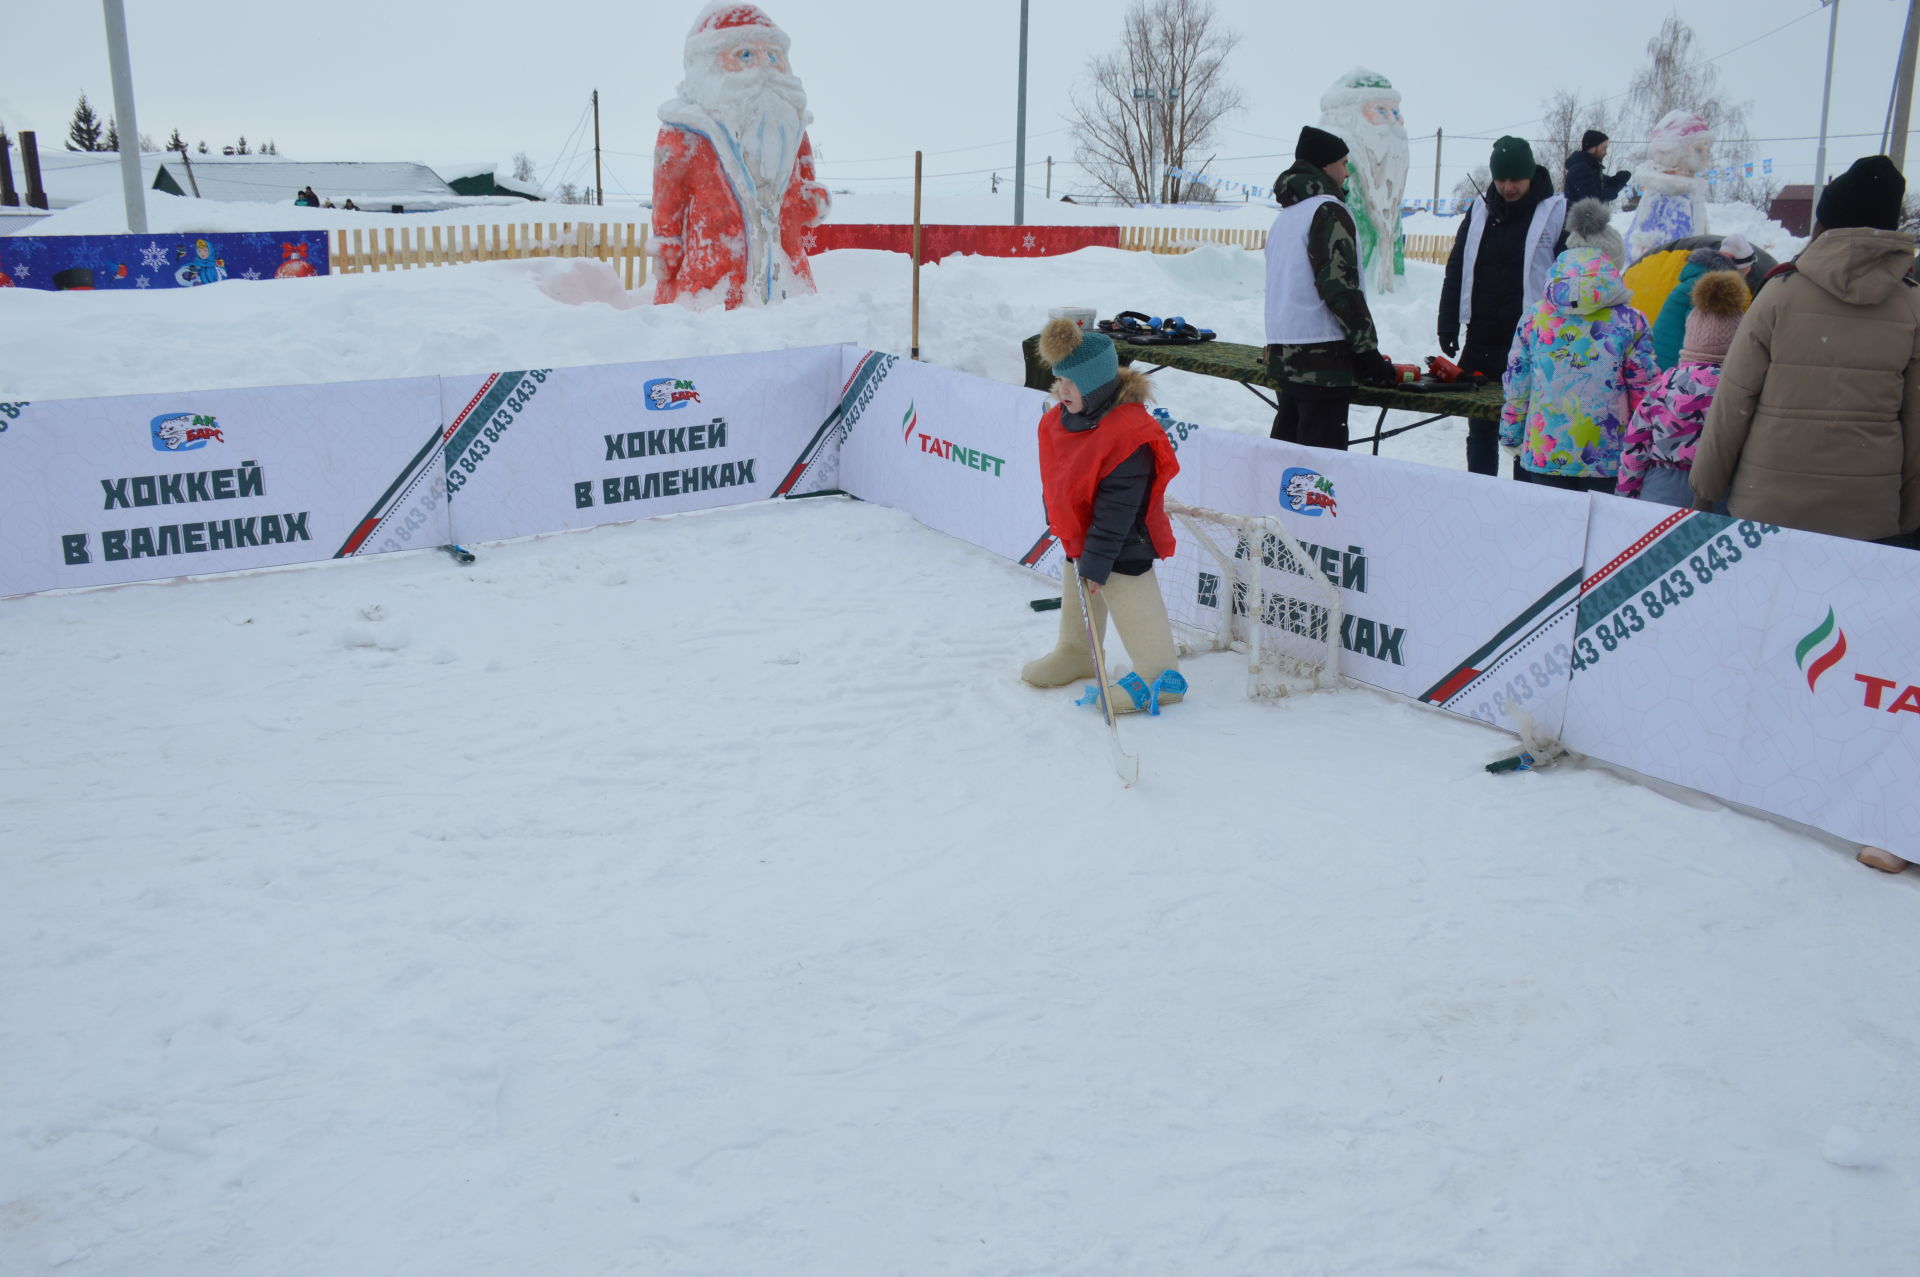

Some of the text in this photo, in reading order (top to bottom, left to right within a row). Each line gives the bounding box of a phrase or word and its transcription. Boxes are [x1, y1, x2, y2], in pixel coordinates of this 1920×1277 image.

[845, 406, 861, 433] 843
[858, 385, 875, 412] 843
[871, 362, 888, 390] 843
[185, 427, 225, 443] БАРС
[459, 438, 491, 474] 843
[483, 408, 514, 443] 843
[506, 379, 537, 414] 843
[603, 417, 729, 461] ХОККЕЙ
[918, 433, 1005, 477] TATNEFT
[101, 459, 267, 510] ХОККЕЙ
[574, 458, 757, 509] В ВАЛЕНКАХ
[61, 511, 313, 565] В ВАЛЕНКАХ
[1595, 603, 1645, 652] 843
[1640, 568, 1695, 619] 843
[1689, 533, 1743, 585] 843
[1529, 643, 1572, 689] 843
